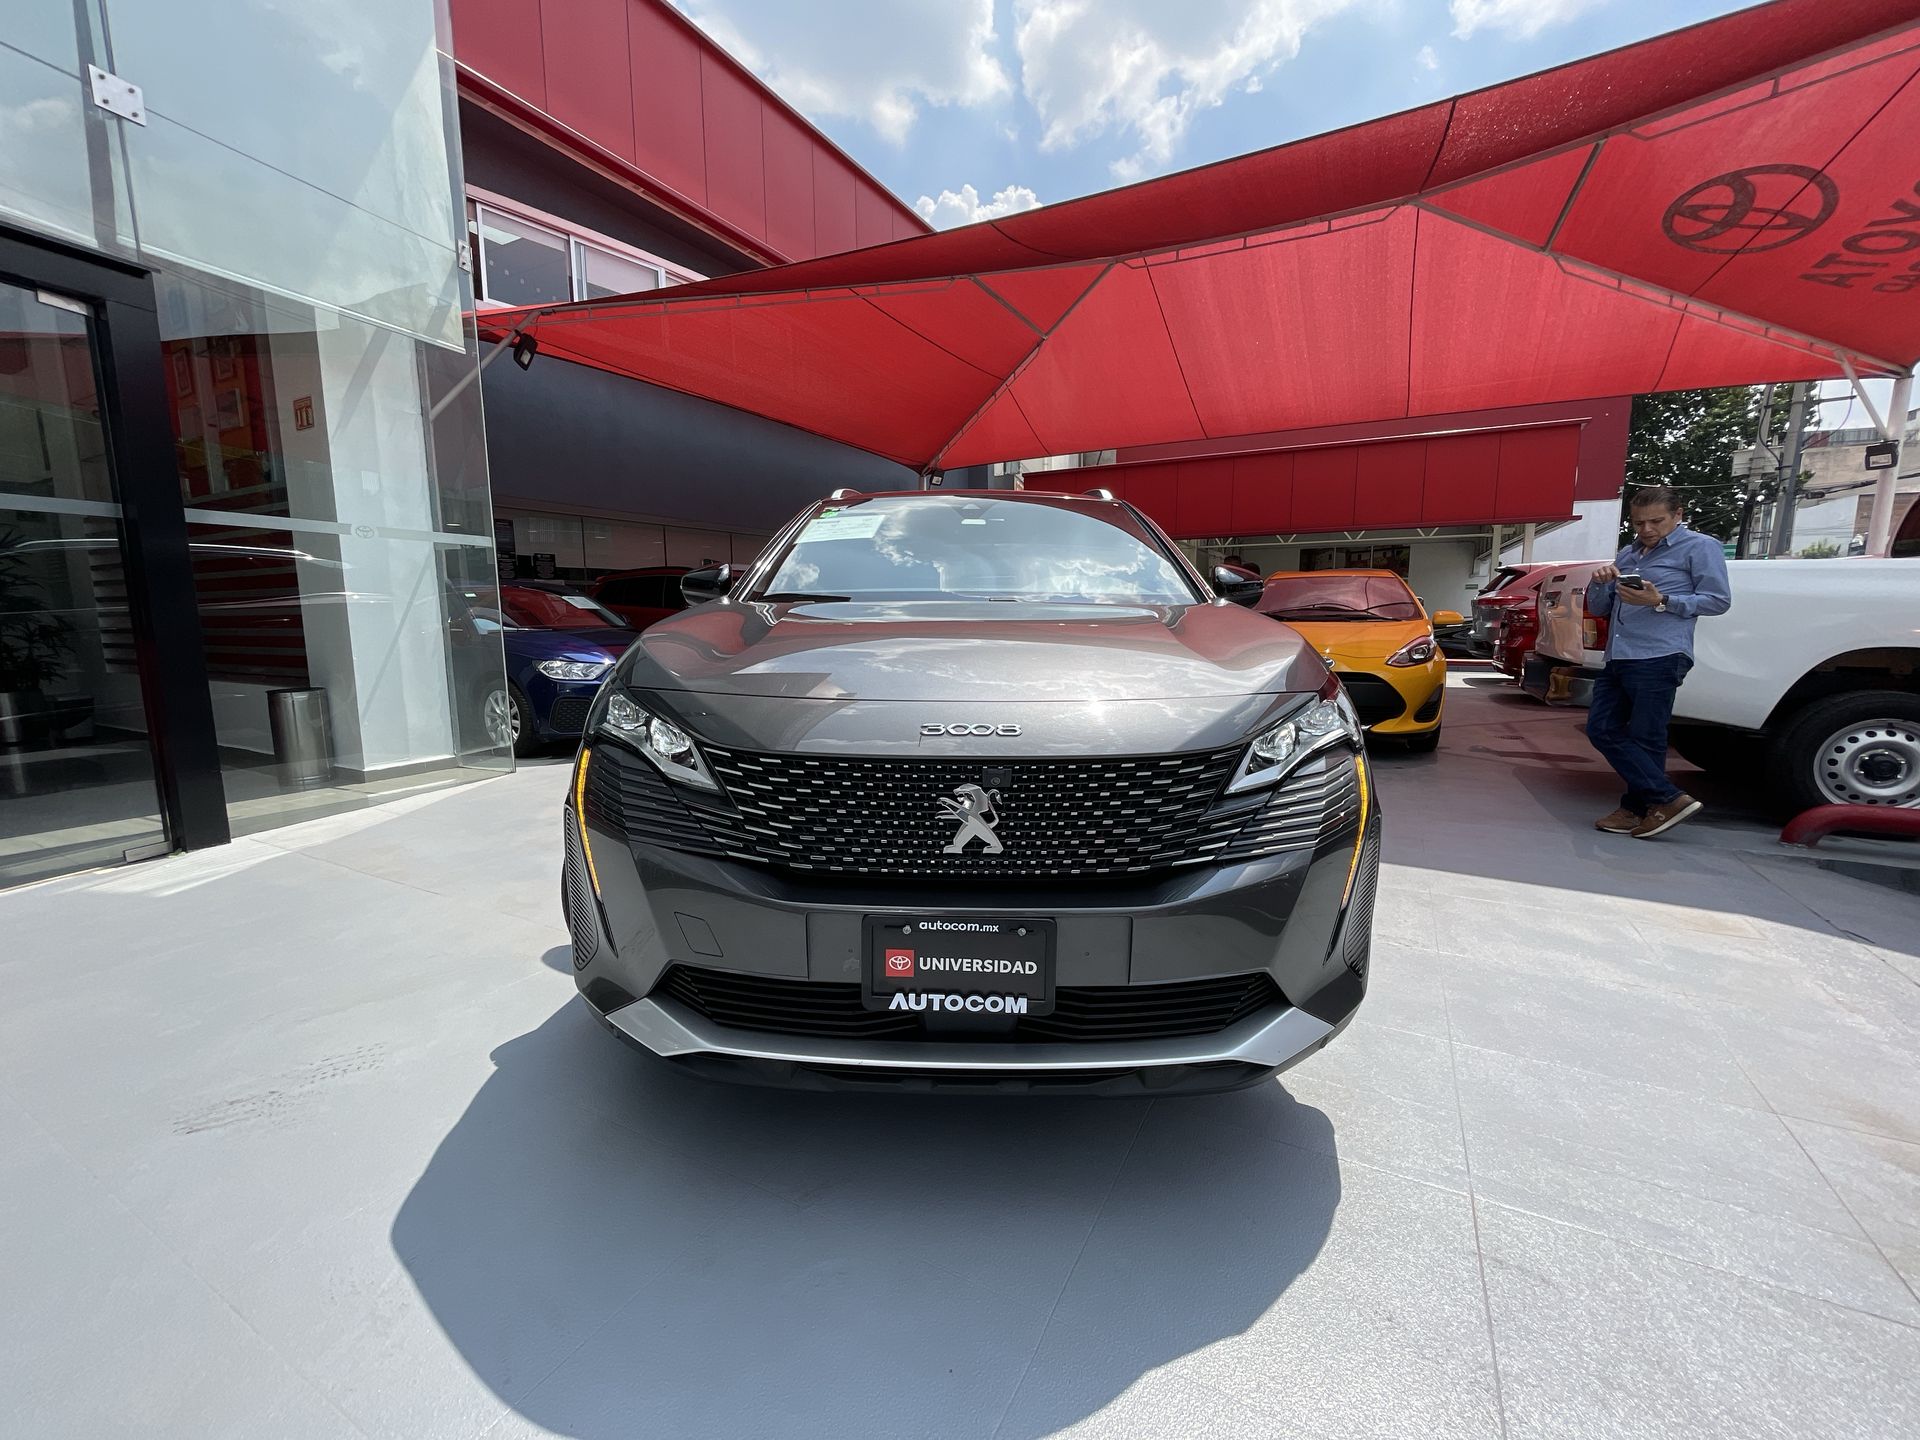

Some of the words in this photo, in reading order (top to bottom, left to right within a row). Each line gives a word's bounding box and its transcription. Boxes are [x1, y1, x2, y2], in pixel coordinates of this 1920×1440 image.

[920, 722, 1022, 736] 3008
[919, 919, 999, 933] autocom.mx
[919, 957, 1038, 975] UNIVERSIDAD
[888, 992, 1028, 1014] AUTOCOM
